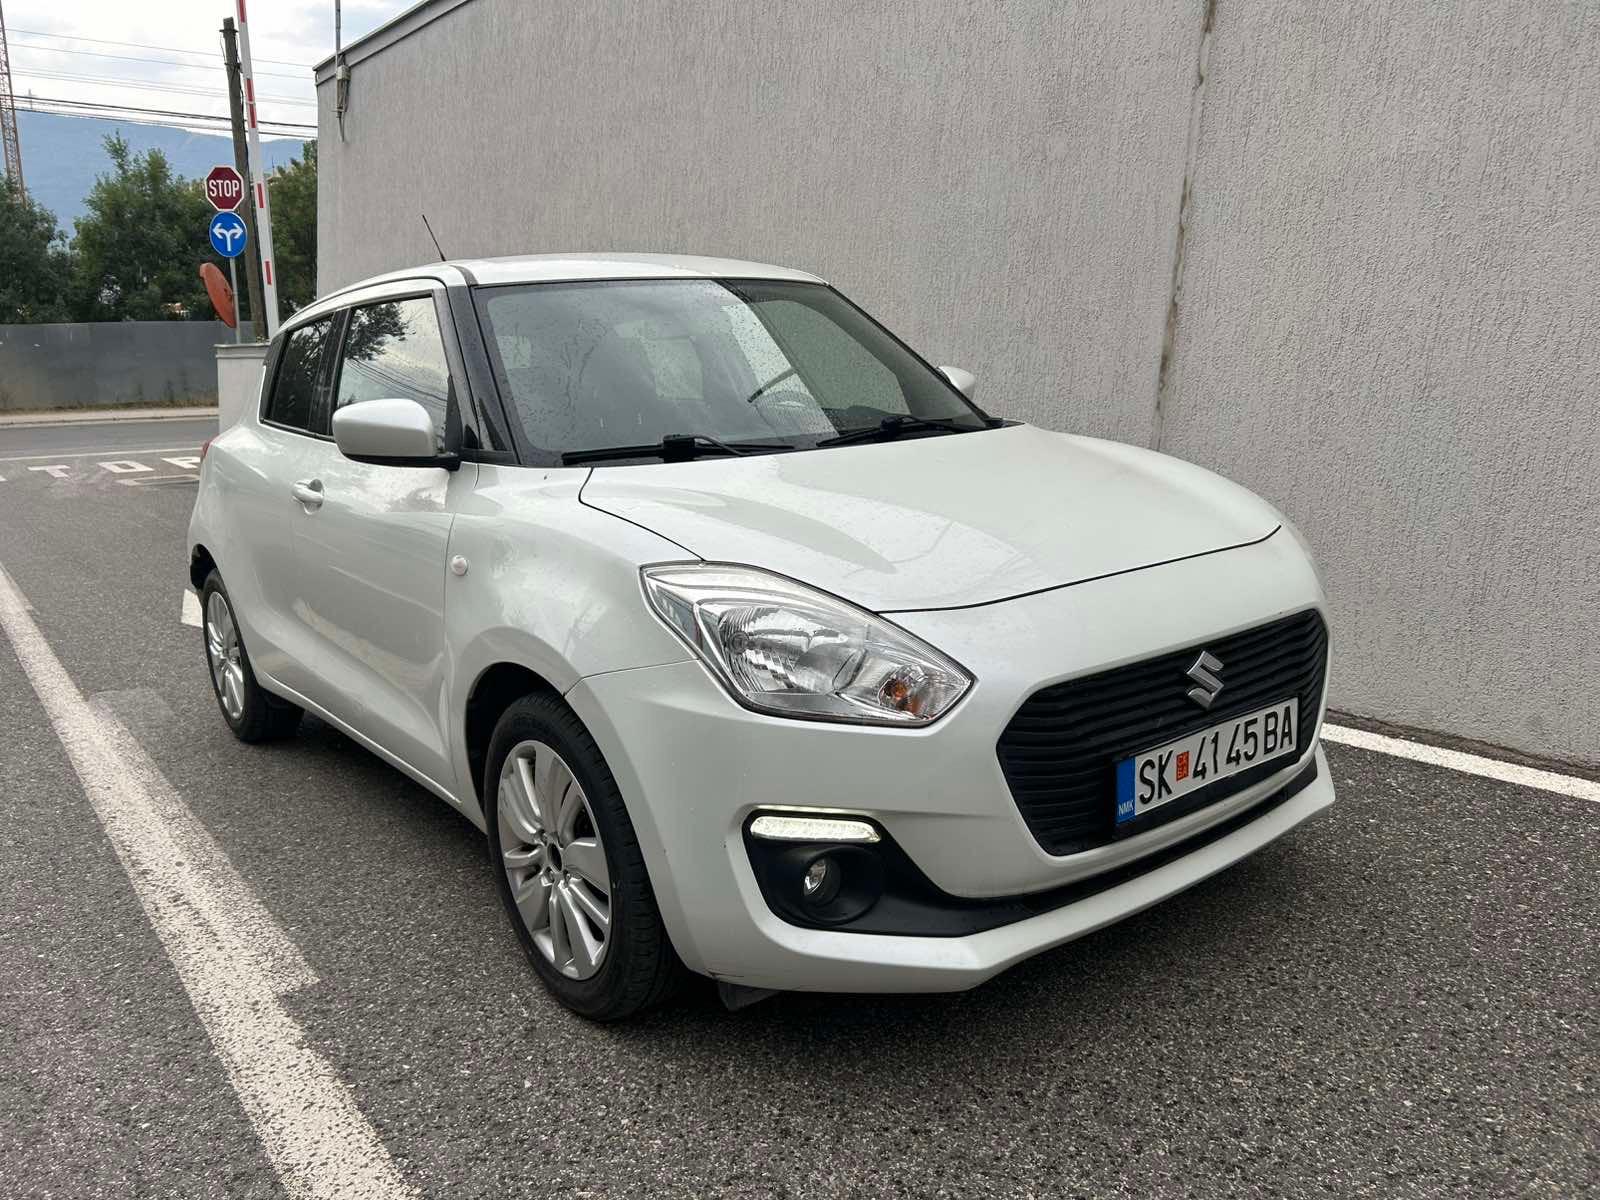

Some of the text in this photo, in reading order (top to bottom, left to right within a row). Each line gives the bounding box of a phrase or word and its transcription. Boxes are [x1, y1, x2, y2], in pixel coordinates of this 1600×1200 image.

[208, 179, 240, 198] STOP
[0, 457, 200, 482] TOP
[1139, 749, 1174, 805] SK
[1118, 799, 1134, 817] NMK
